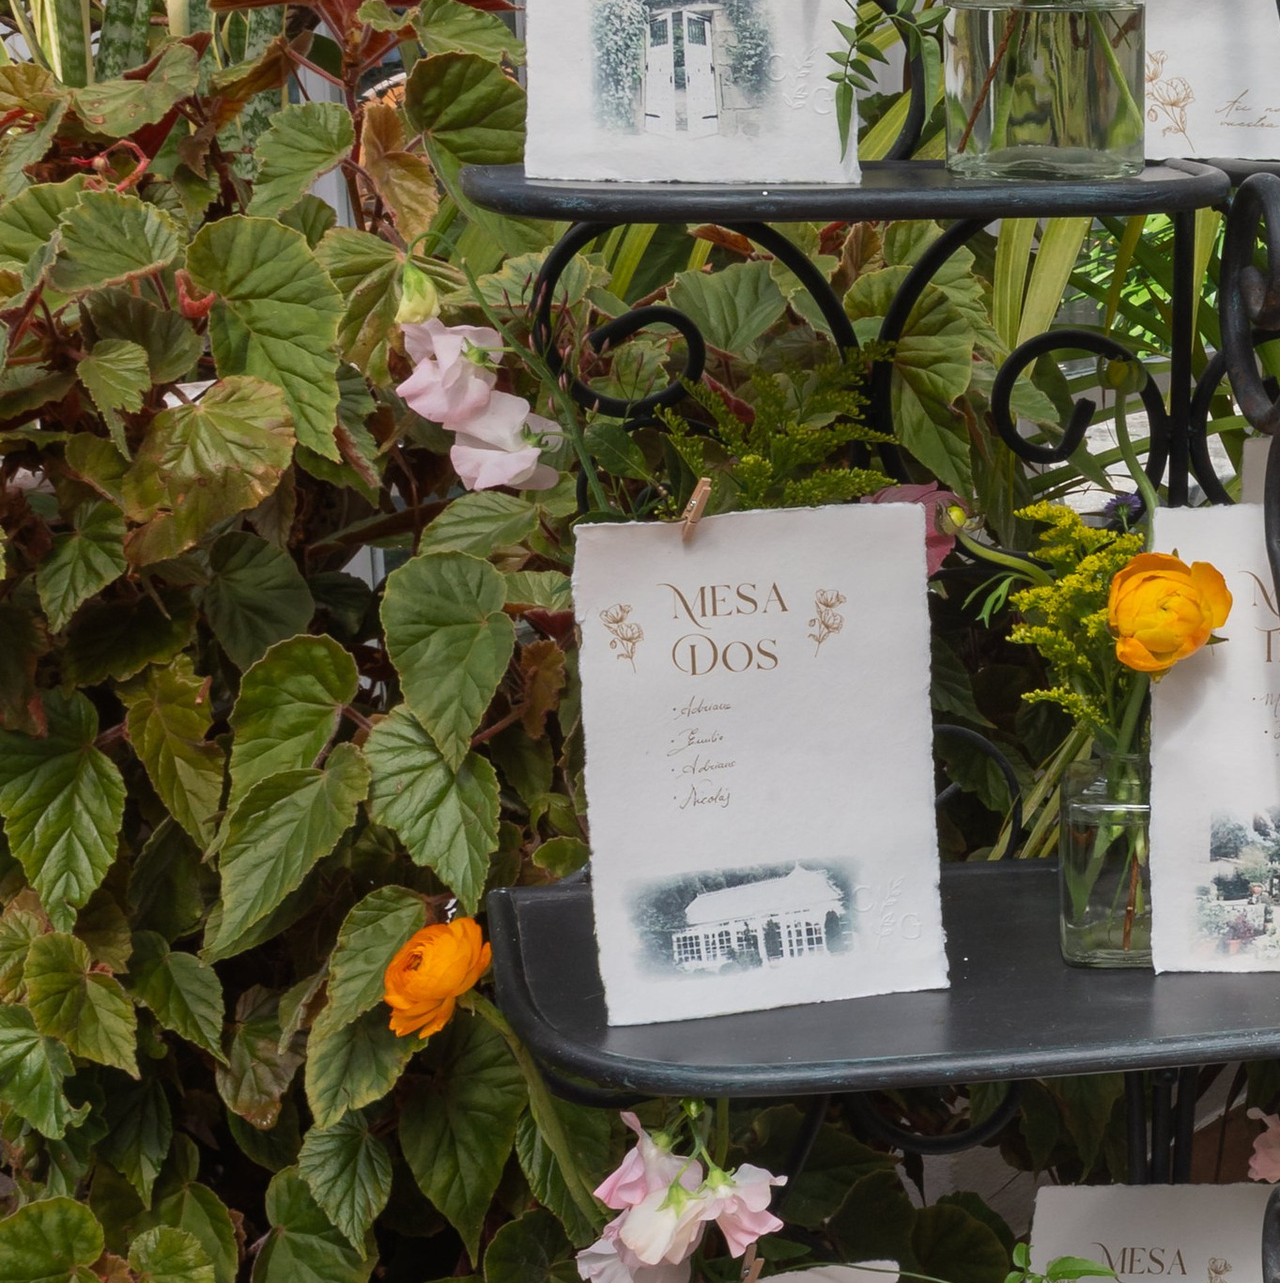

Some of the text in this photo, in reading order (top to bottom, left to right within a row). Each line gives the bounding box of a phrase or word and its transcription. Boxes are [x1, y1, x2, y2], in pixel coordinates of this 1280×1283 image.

[1219, 116, 1279, 129] vuestra
[657, 581, 789, 630] MESA
[671, 633, 780, 676] DOS
[1093, 1242, 1188, 1283] MESA
